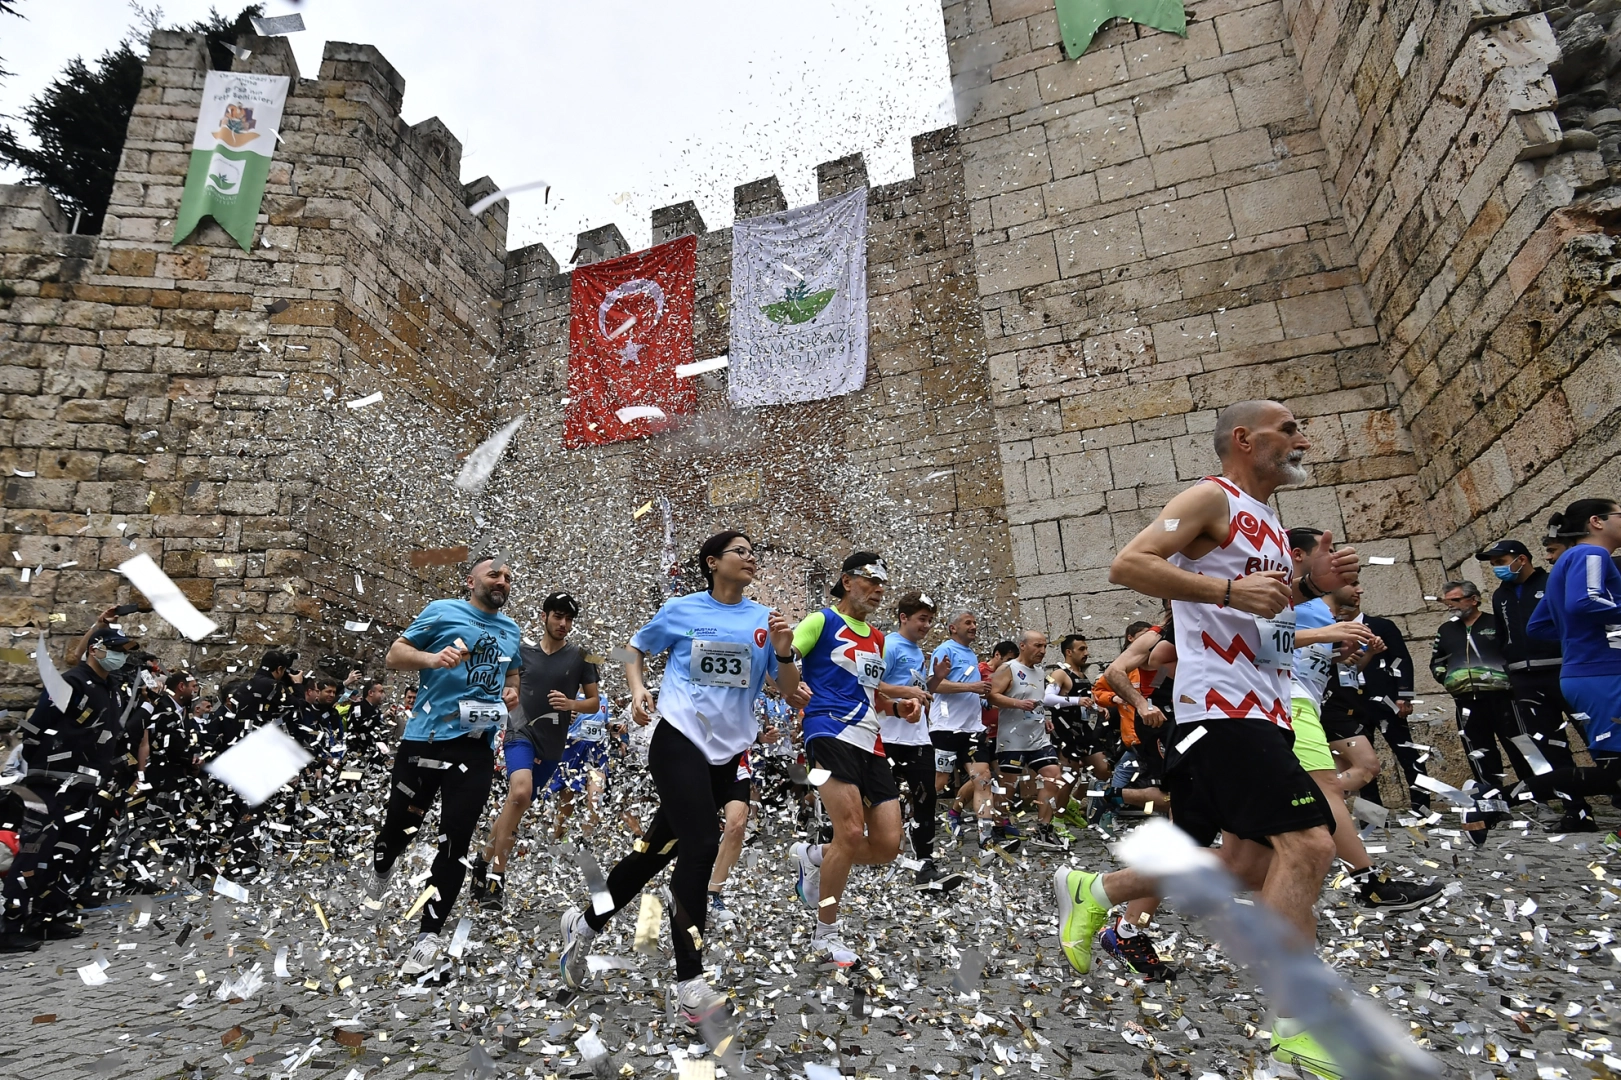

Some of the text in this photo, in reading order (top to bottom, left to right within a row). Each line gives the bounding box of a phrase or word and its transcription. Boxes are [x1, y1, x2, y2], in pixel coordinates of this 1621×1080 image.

[700, 656, 742, 675] 633
[864, 663, 886, 680] 667
[468, 709, 501, 723] 553
